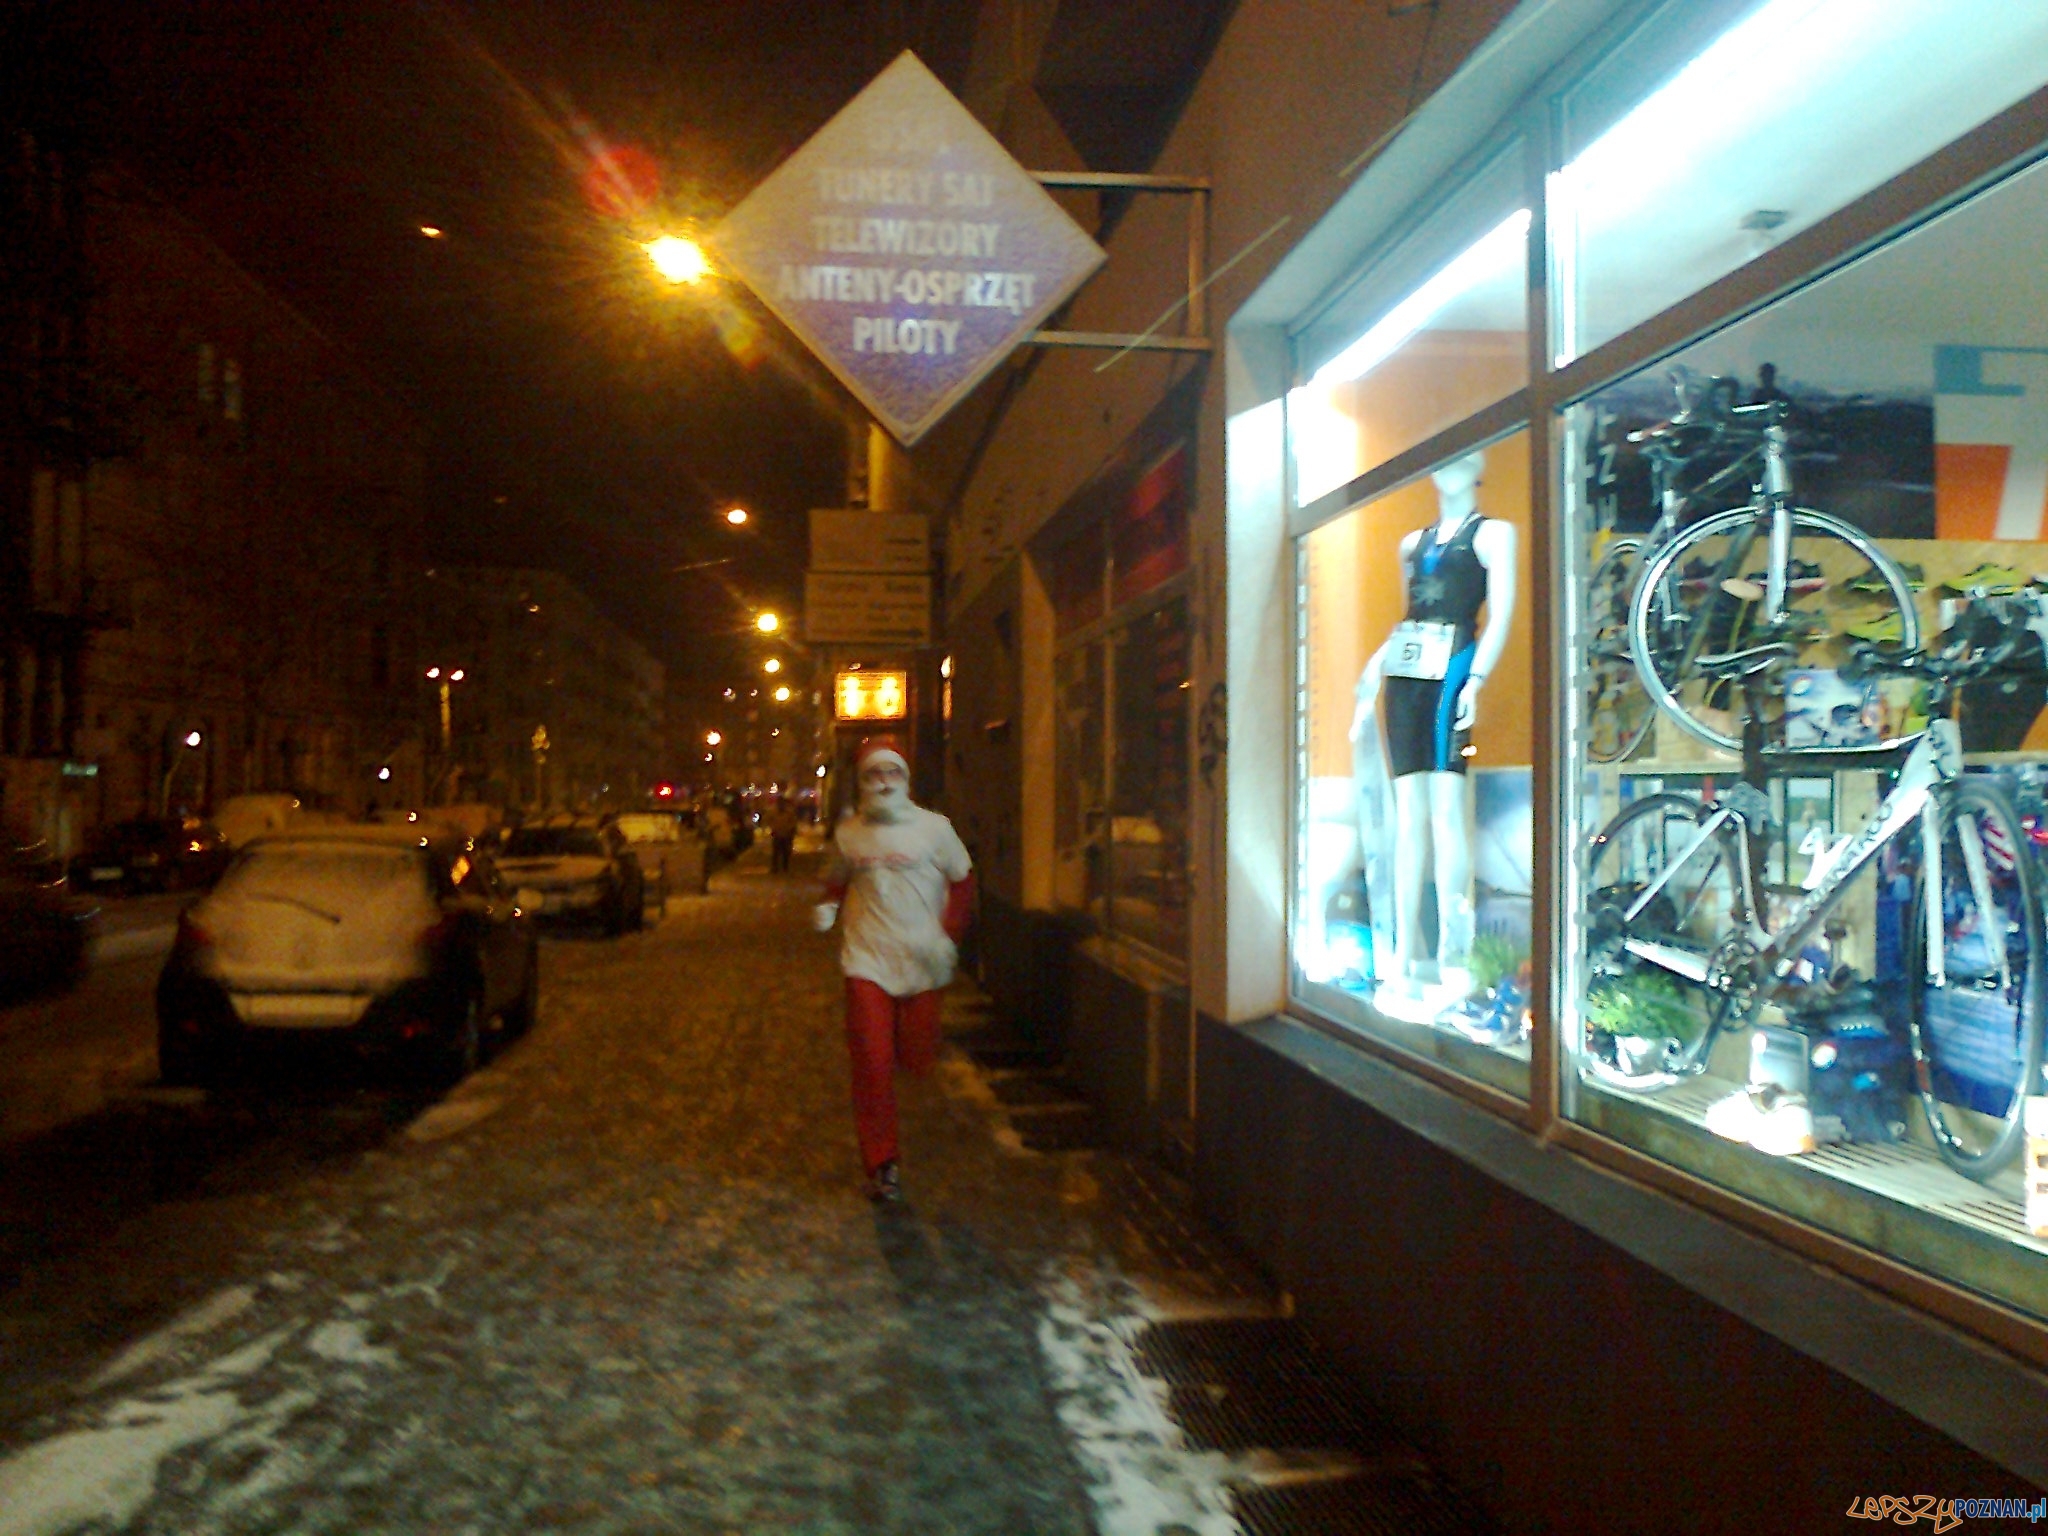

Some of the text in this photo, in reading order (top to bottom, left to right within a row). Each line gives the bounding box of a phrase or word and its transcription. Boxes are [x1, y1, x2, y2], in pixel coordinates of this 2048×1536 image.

[942, 172, 996, 207] SAT
[813, 216, 1000, 256] TELEWIZORY
[852, 317, 961, 354] PILOTY
